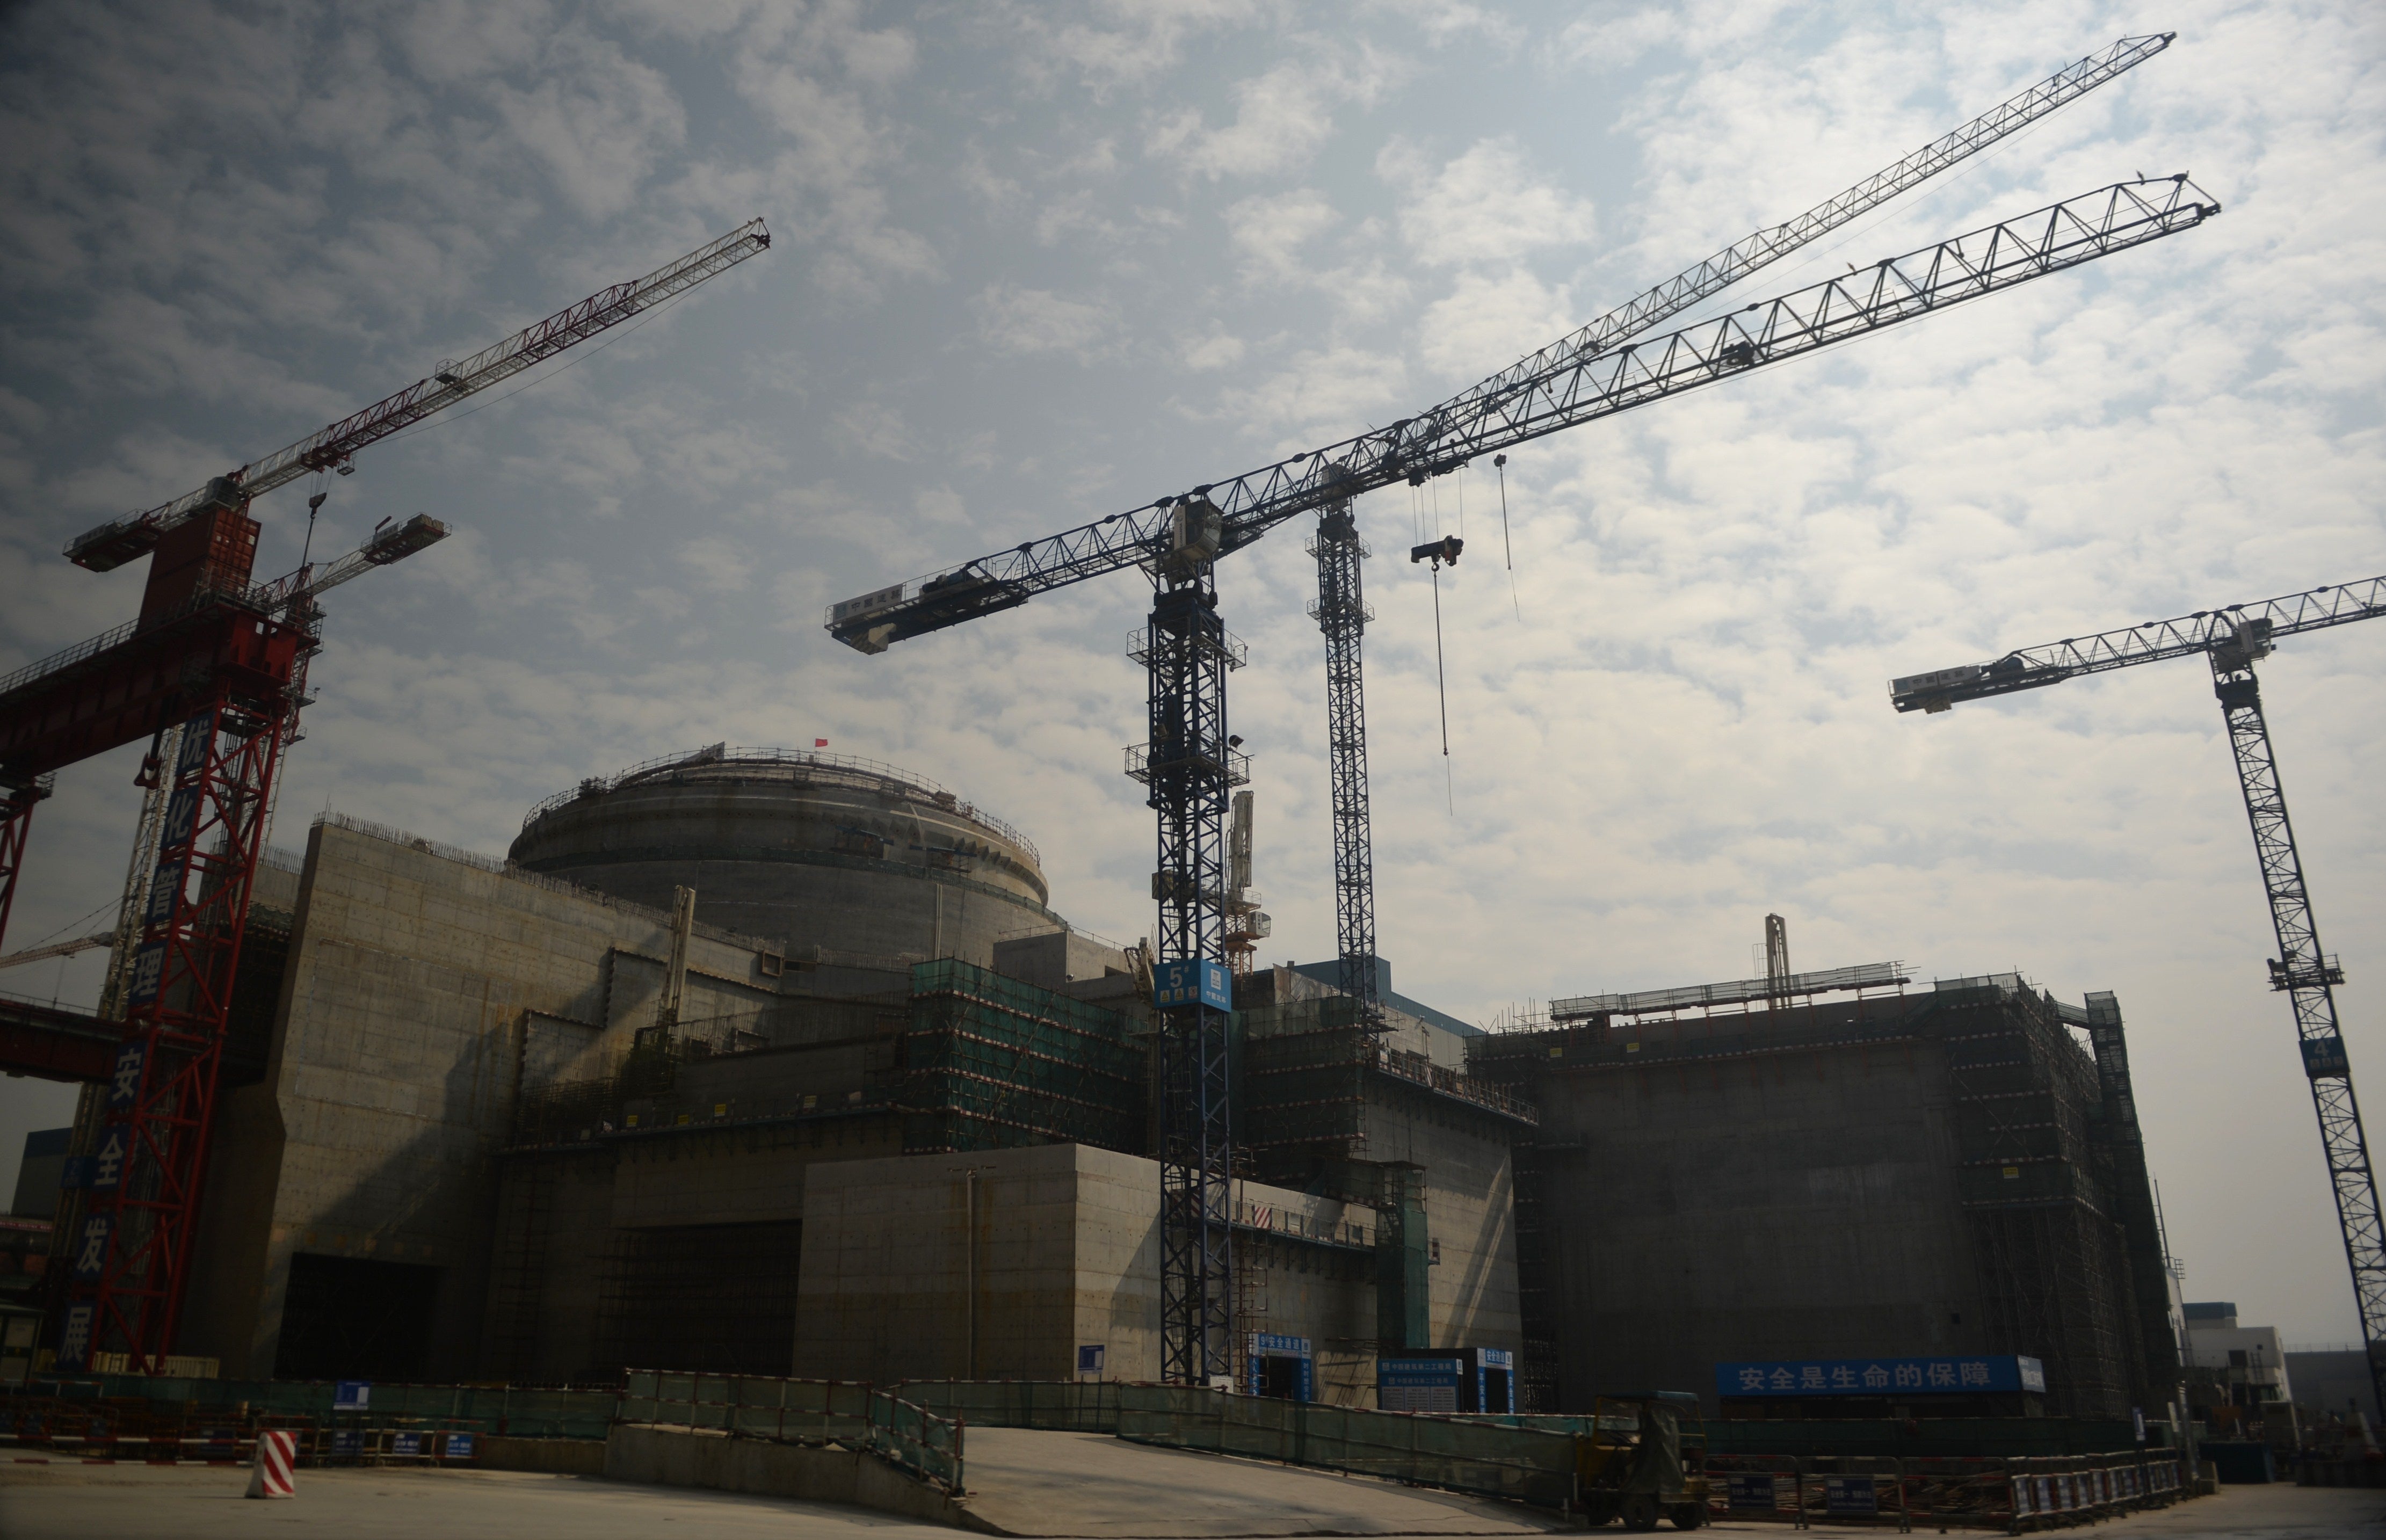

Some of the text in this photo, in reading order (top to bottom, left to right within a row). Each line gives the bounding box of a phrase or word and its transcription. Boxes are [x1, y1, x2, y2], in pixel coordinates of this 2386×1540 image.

[1739, 1362, 1992, 1390] 安全是生命的保障
